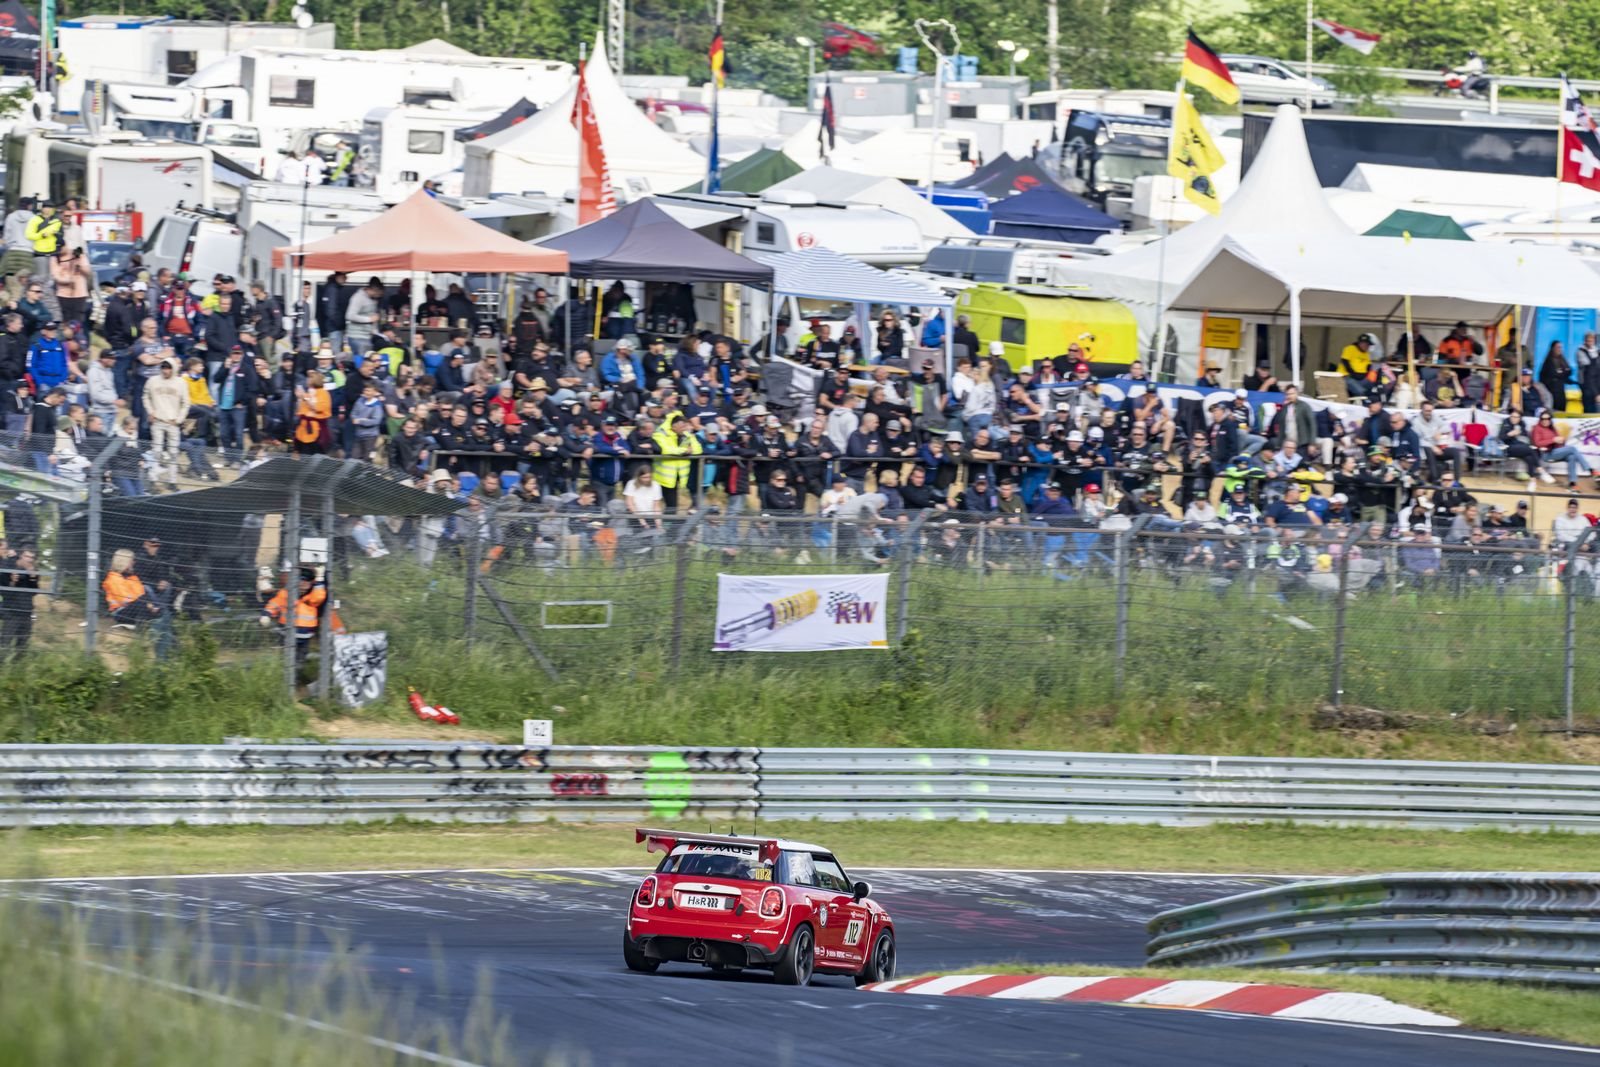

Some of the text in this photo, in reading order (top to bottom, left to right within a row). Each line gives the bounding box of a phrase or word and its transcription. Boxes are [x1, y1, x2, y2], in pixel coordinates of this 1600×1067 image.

[835, 601, 878, 624] KW
[694, 844, 752, 856] REMUS
[847, 922, 859, 944] 112
